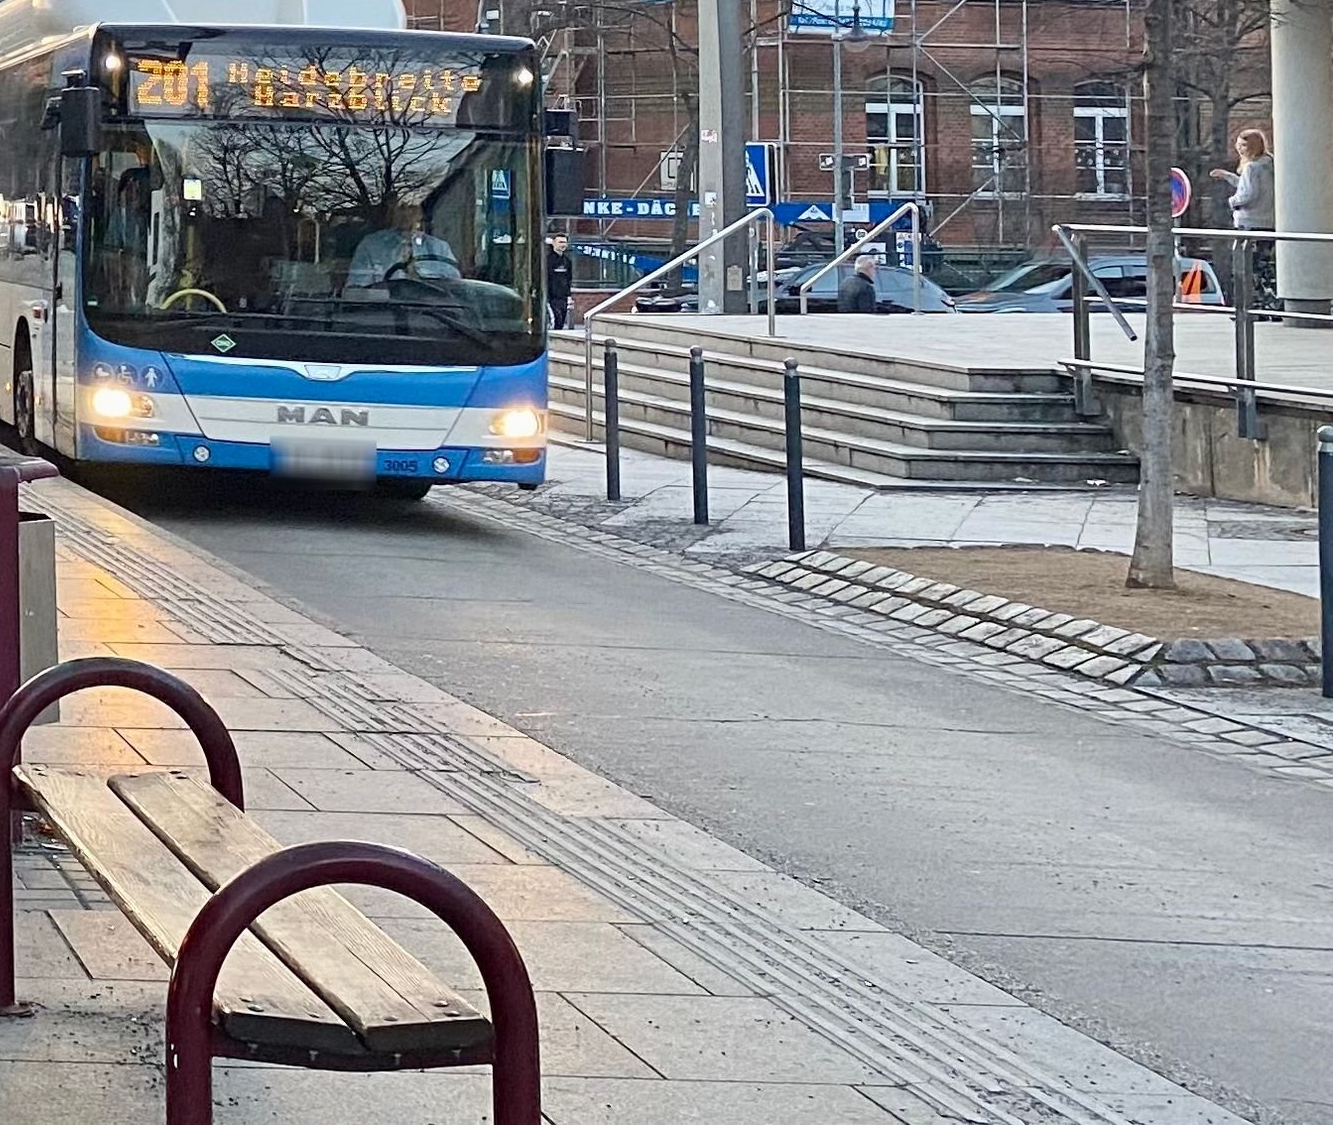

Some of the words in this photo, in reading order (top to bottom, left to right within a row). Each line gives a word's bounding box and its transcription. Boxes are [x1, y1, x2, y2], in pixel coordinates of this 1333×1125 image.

[135, 58, 210, 108] 201
[228, 62, 484, 93] Heidebreite
[253, 85, 453, 114] Harzblick
[276, 404, 370, 426] MAN
[383, 459, 419, 474] 3005
